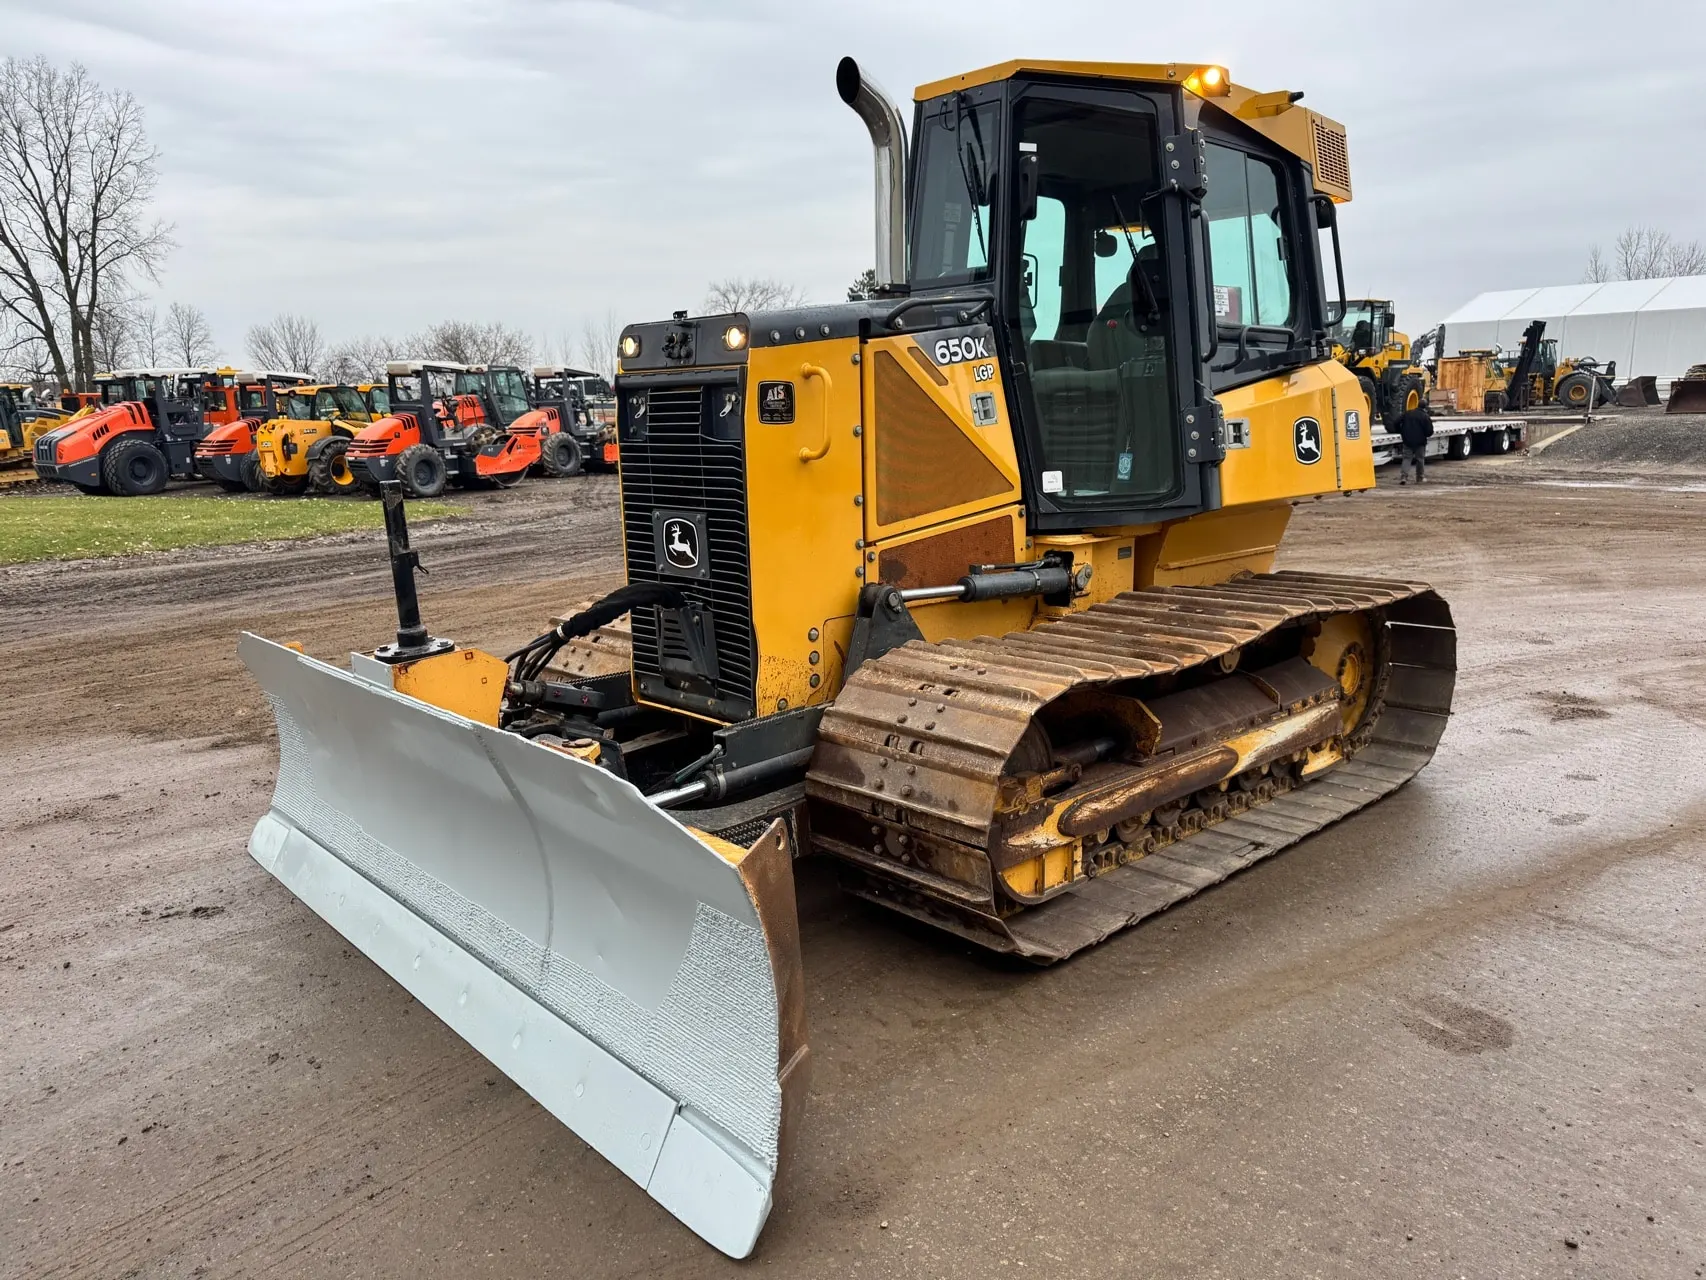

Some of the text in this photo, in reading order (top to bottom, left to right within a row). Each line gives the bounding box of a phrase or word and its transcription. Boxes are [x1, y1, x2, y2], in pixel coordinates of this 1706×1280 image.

[935, 336, 989, 364] 650K
[973, 365, 995, 382] LGP
[766, 385, 785, 401] AIS
